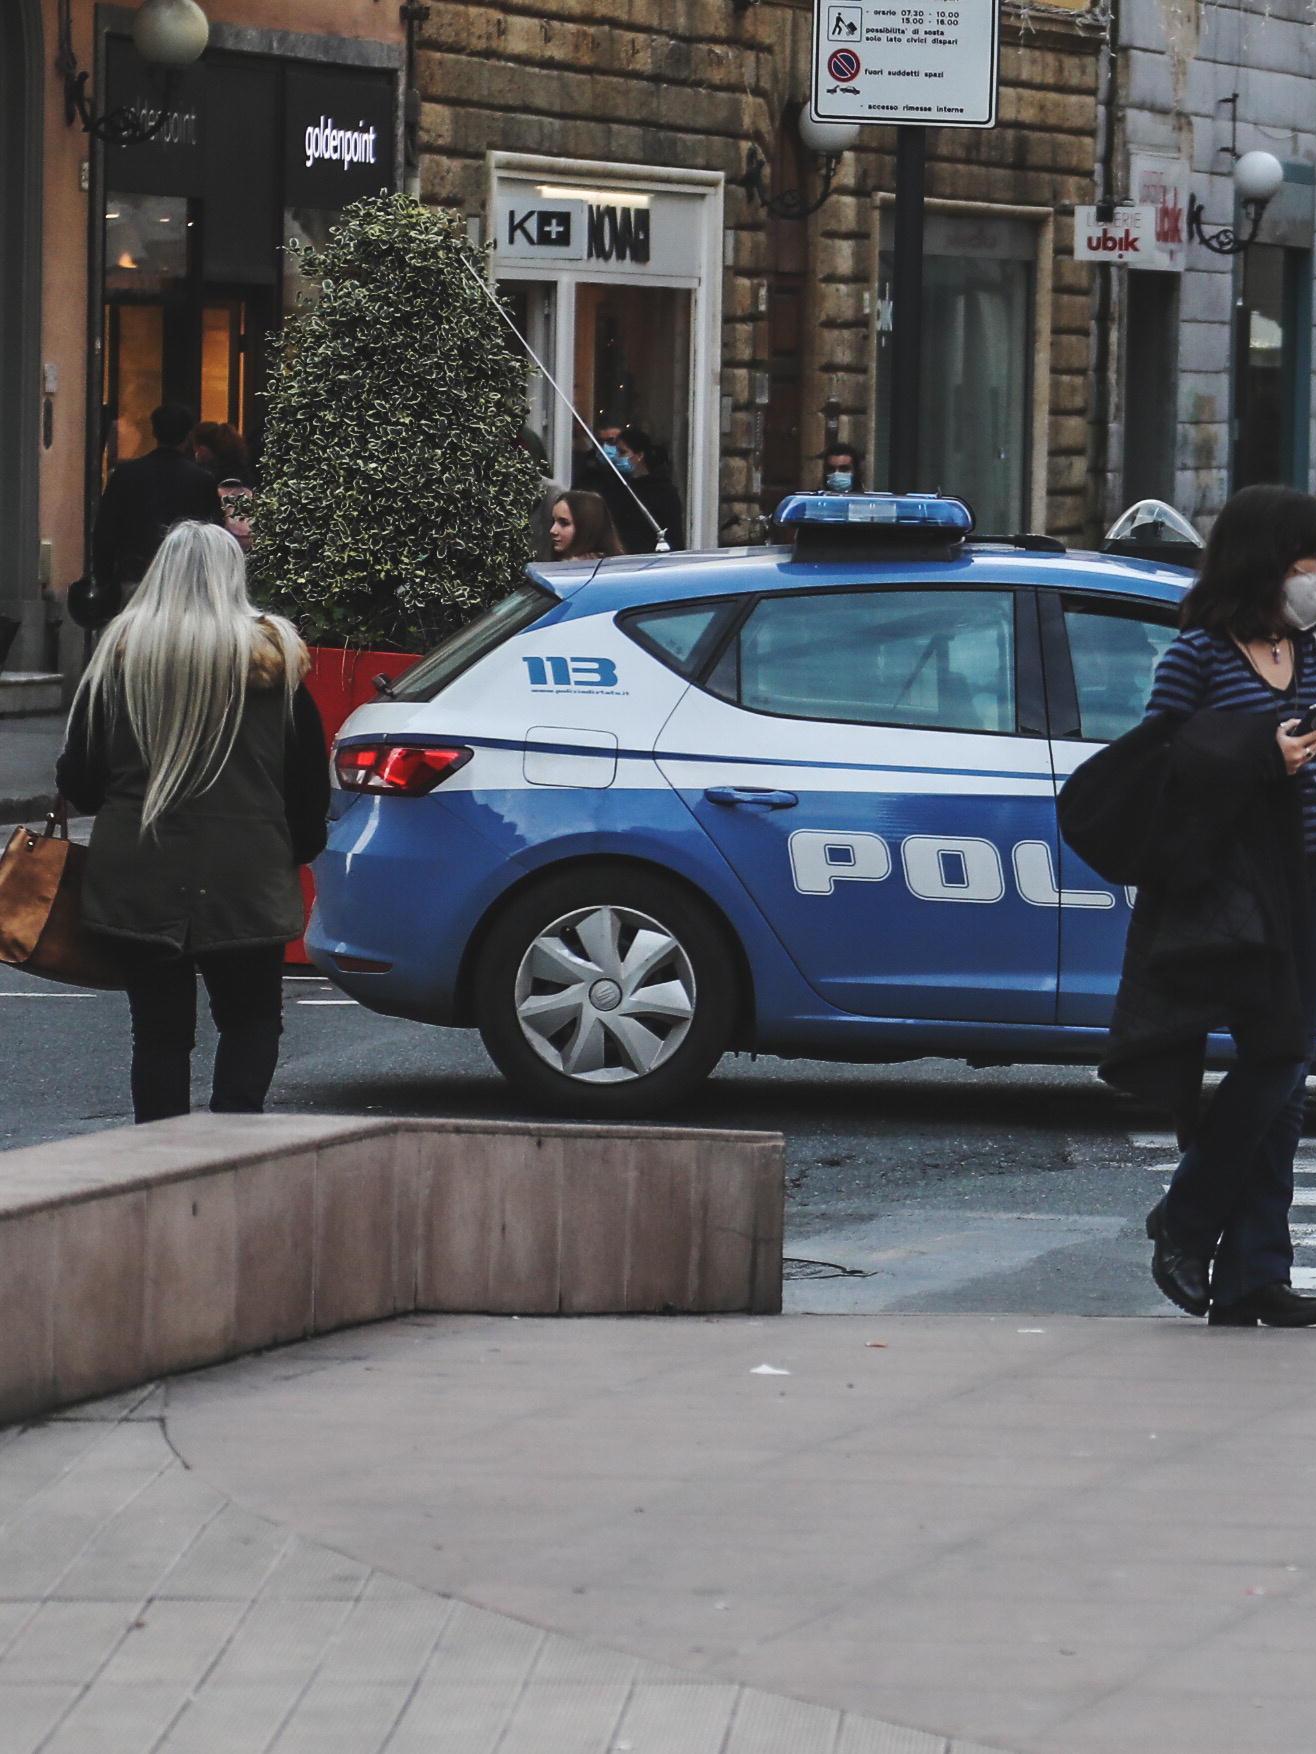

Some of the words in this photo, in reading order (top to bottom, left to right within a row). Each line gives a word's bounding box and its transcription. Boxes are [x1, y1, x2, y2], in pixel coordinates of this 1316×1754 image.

[873, 9, 897, 17] orario
[900, 9, 925, 18] 07.30
[936, 11, 960, 19] 10.00
[901, 17, 924, 25] 15.00
[931, 38, 959, 46] dispari
[864, 68, 884, 76] fuori
[887, 69, 920, 78] suddetti
[923, 71, 945, 80] spazi
[902, 105, 933, 113] rimesse
[936, 105, 965, 114] interne
[305, 115, 376, 171] goldenpoint
[1086, 227, 1140, 259] ubik
[522, 656, 618, 688] 113
